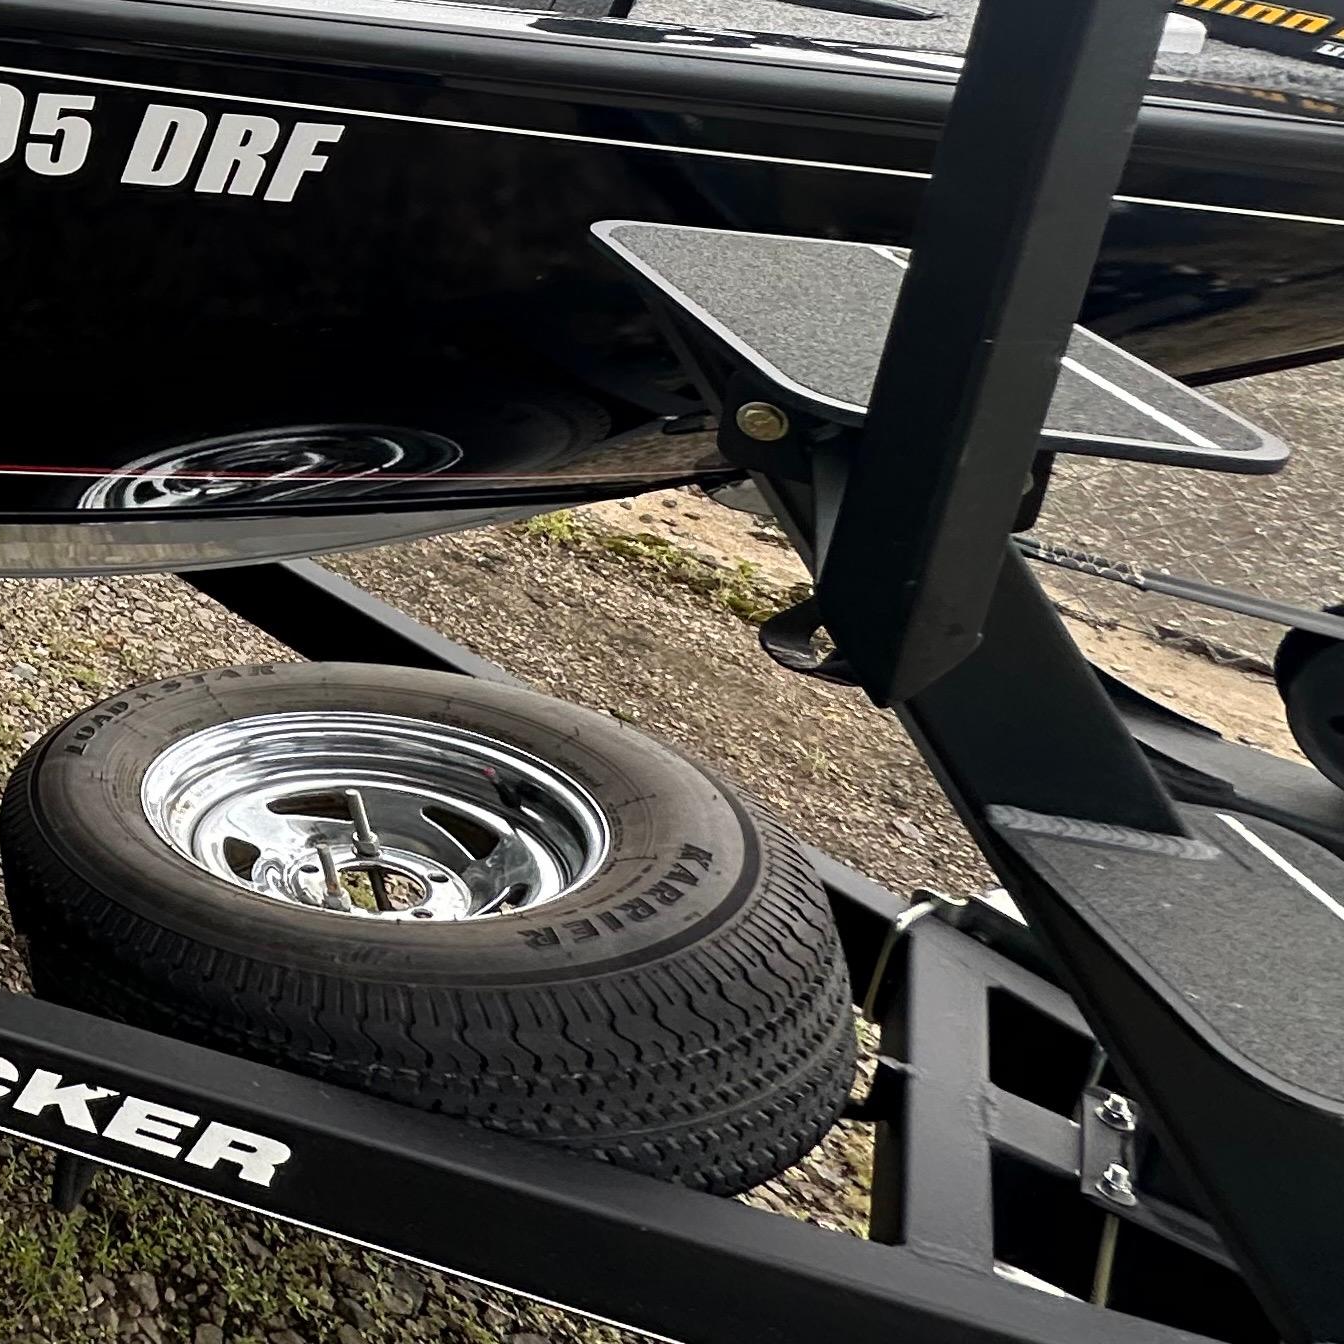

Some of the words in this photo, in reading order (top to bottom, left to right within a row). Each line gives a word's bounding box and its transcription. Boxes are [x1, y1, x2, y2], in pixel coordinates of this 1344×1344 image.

[120, 103, 346, 203] DRF
[63, 700, 129, 757] LOAD
[518, 843, 713, 950] KARRIER
